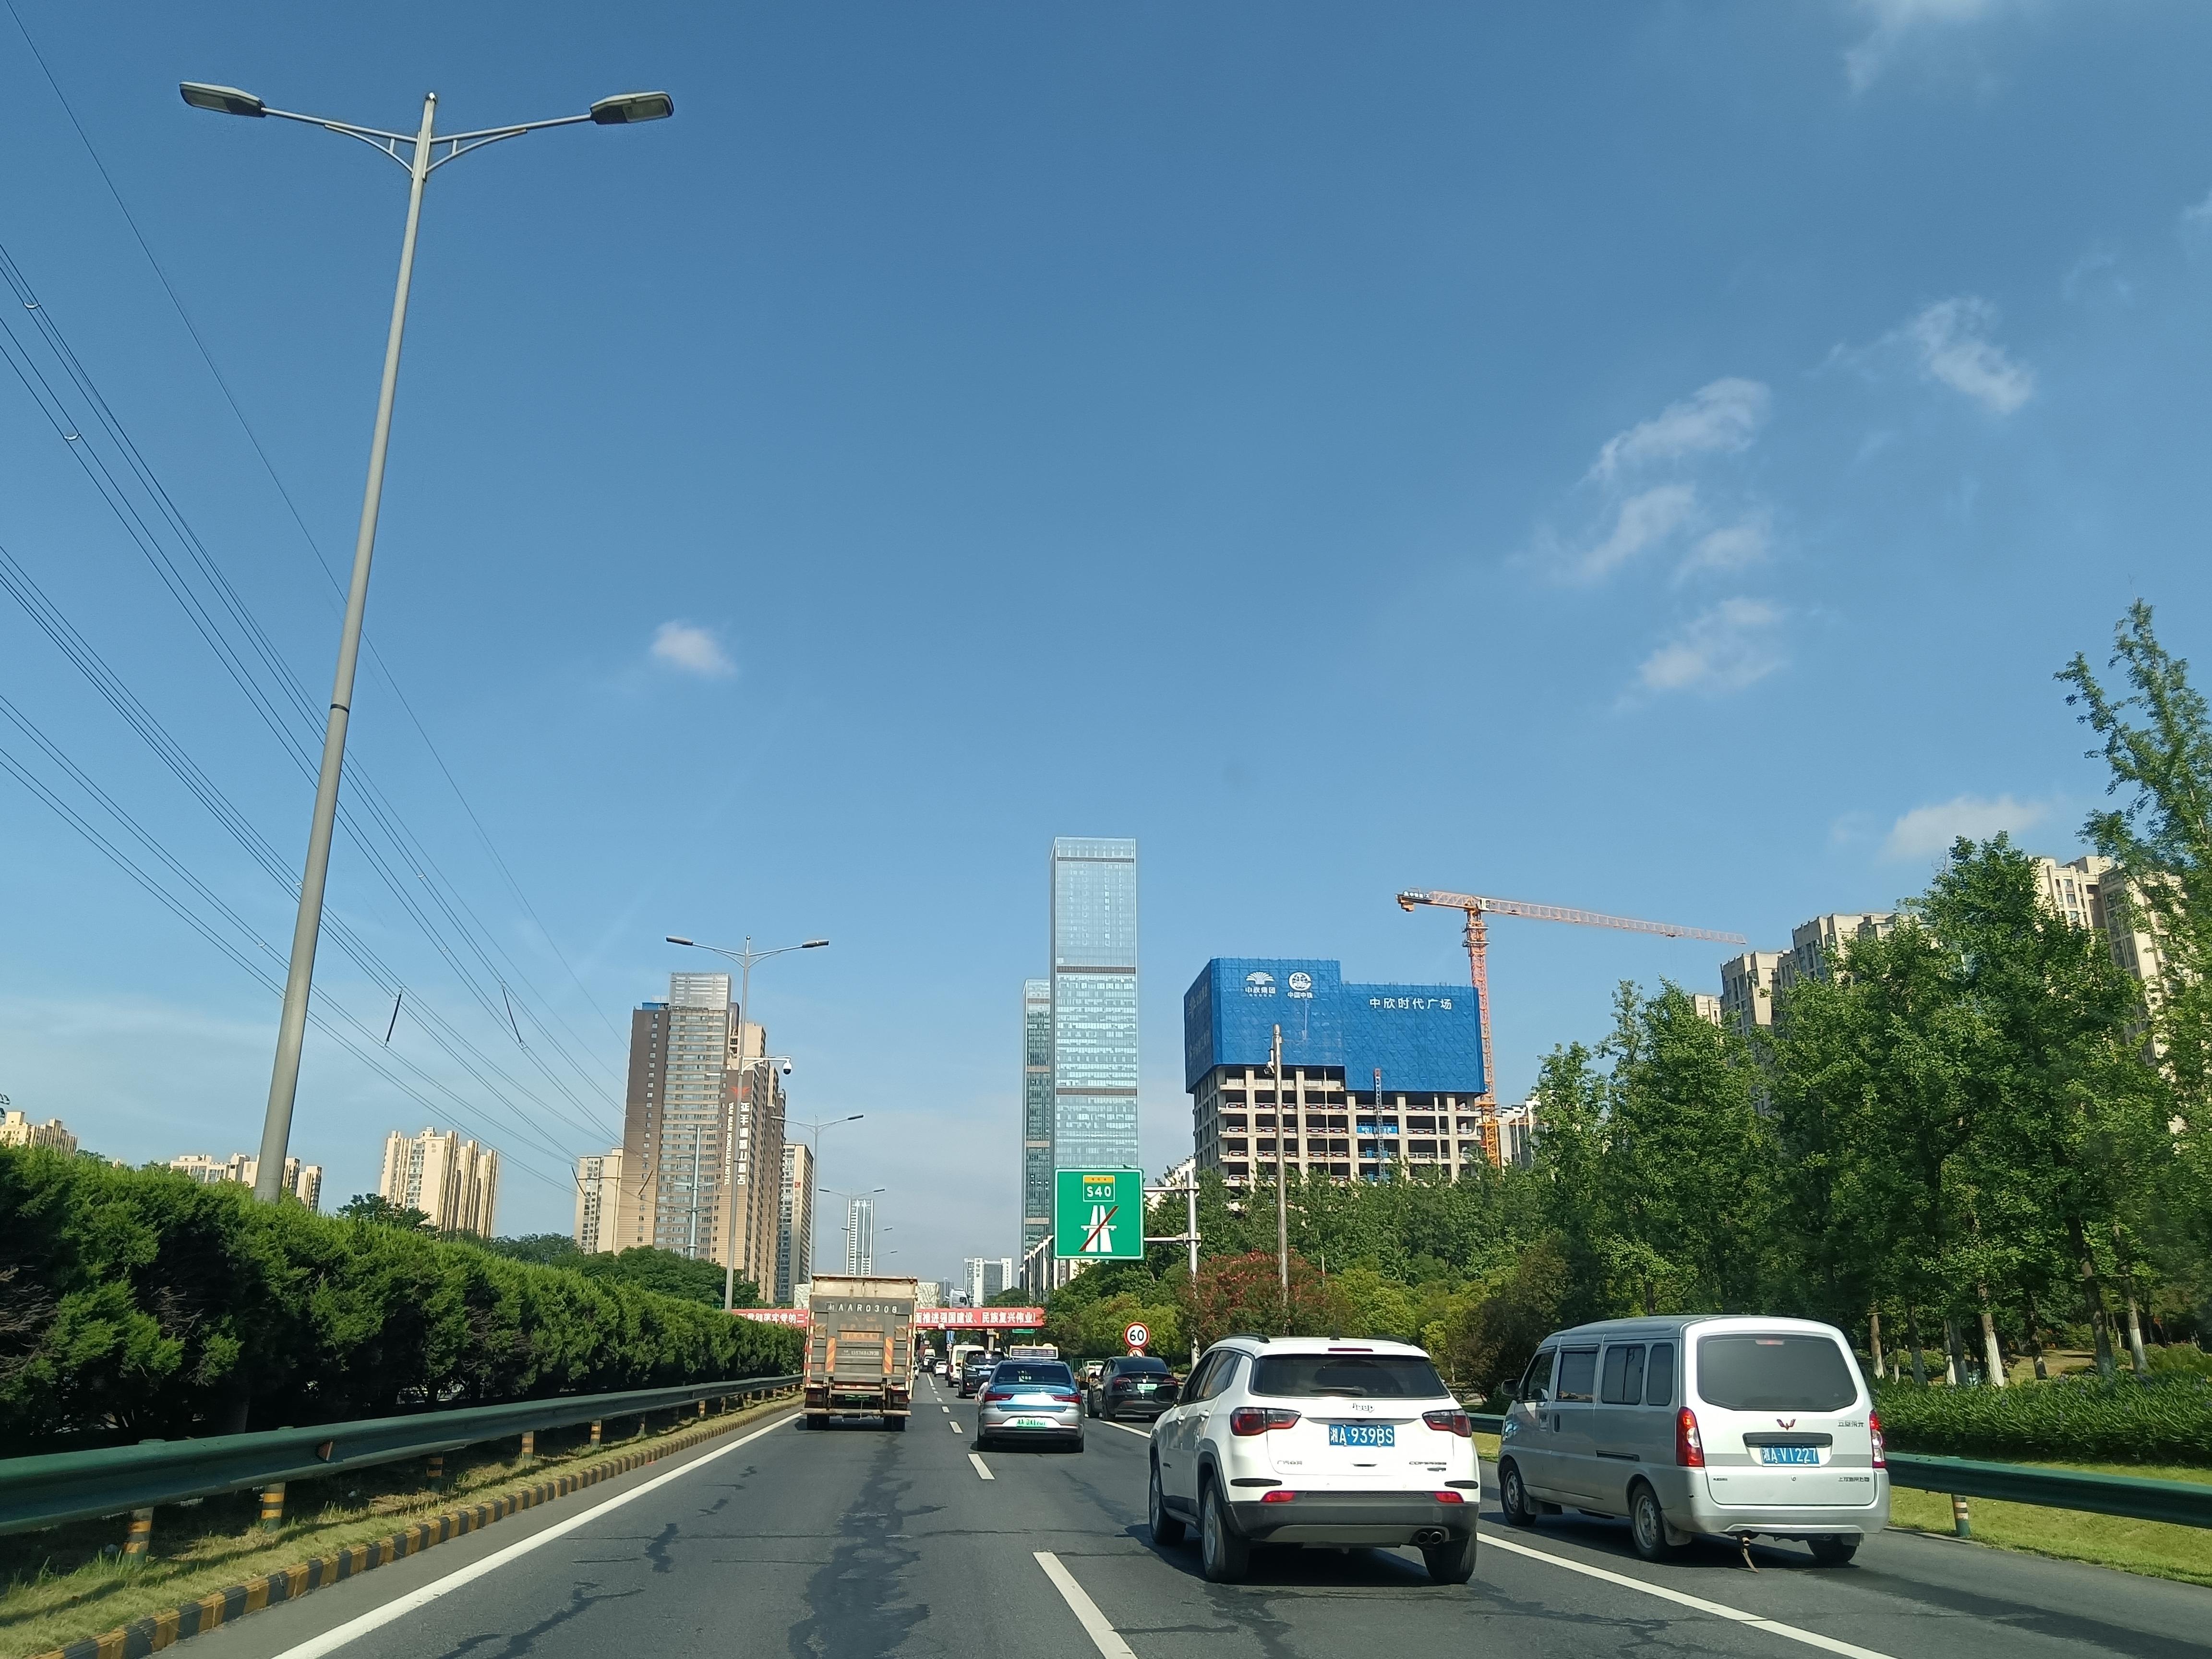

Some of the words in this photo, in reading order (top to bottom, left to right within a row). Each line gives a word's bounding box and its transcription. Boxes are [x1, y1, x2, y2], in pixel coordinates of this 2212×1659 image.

[1369, 997, 1452, 1010] 中欣时代广场
[1086, 1186, 1111, 1197] S40
[1130, 1330, 1144, 1341] 60
[1351, 1403, 1375, 1413] Jeep
